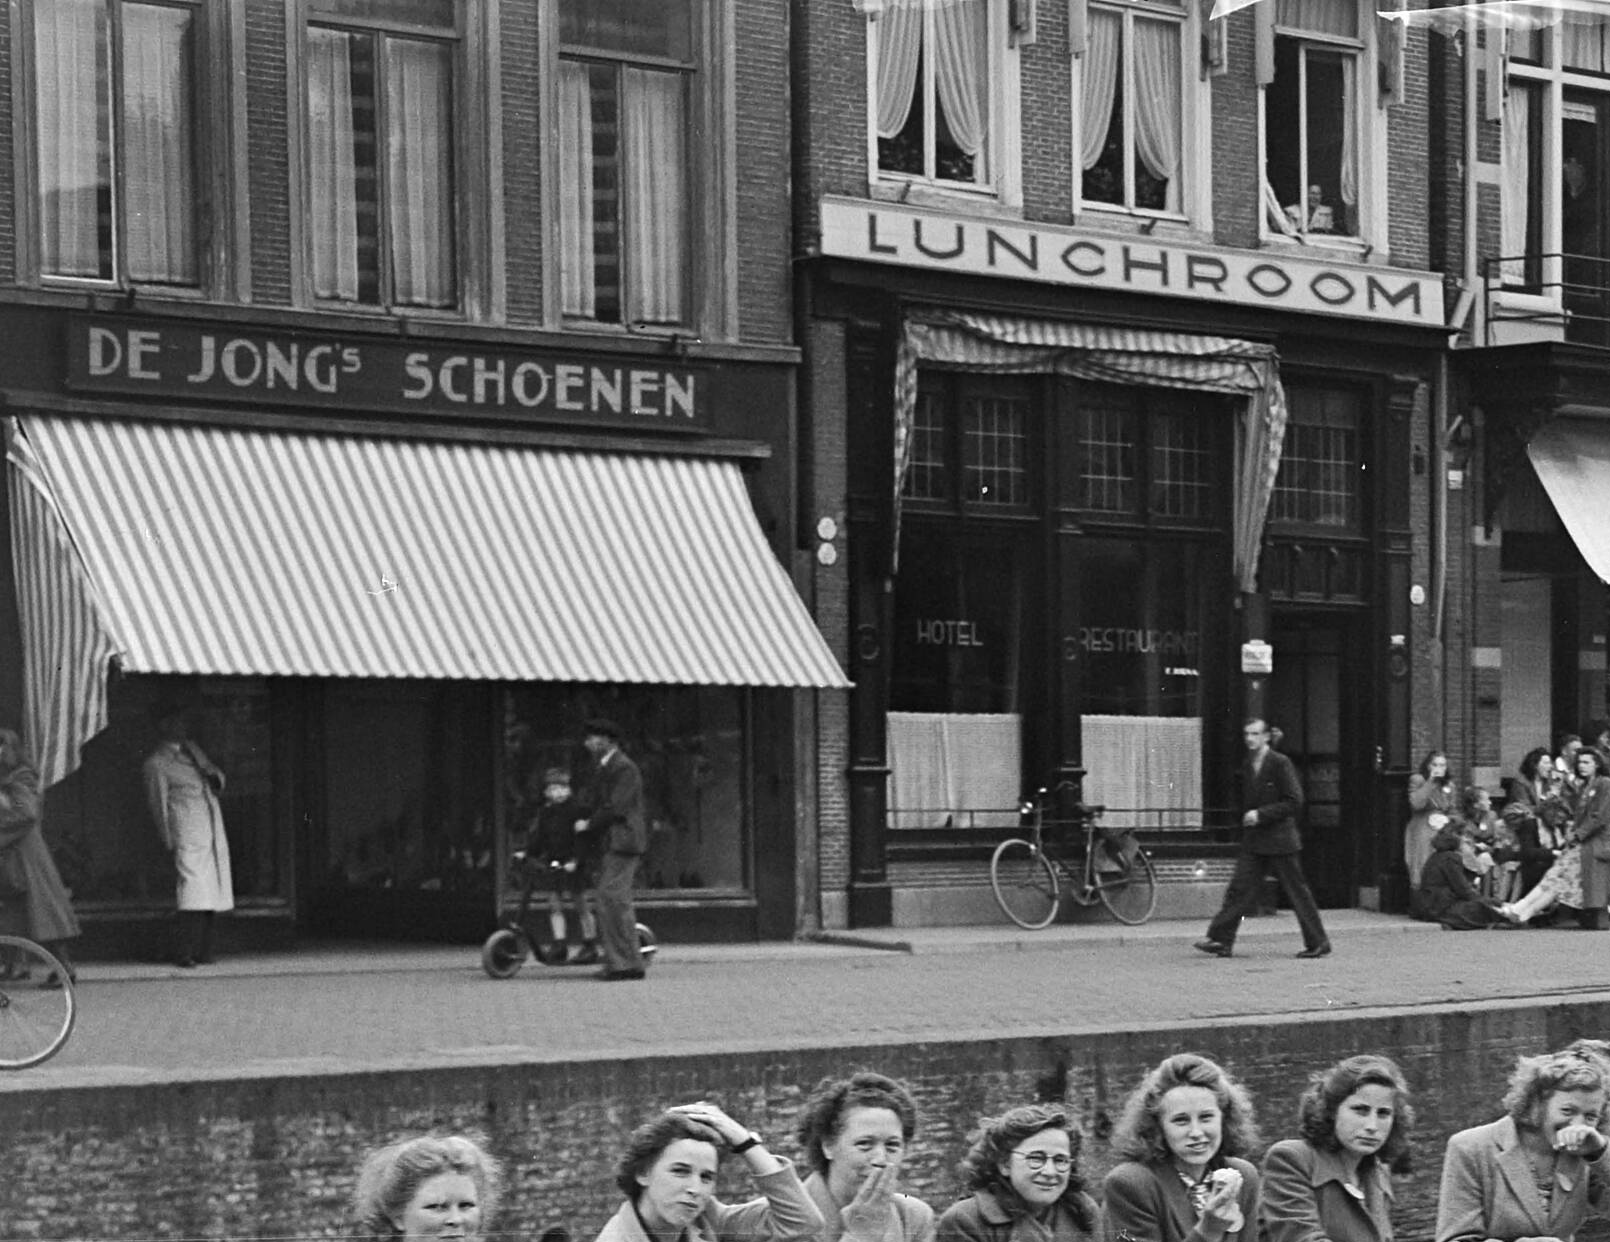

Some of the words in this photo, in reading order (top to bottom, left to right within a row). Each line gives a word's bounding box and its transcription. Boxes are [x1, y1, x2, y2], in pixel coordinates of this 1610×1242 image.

[867, 212, 1423, 317] LUNCHROOM
[88, 327, 162, 381] DE
[403, 351, 697, 418] SCHOENEN
[916, 618, 985, 647] HOTEL
[1079, 626, 1199, 655] RESTAURANT
